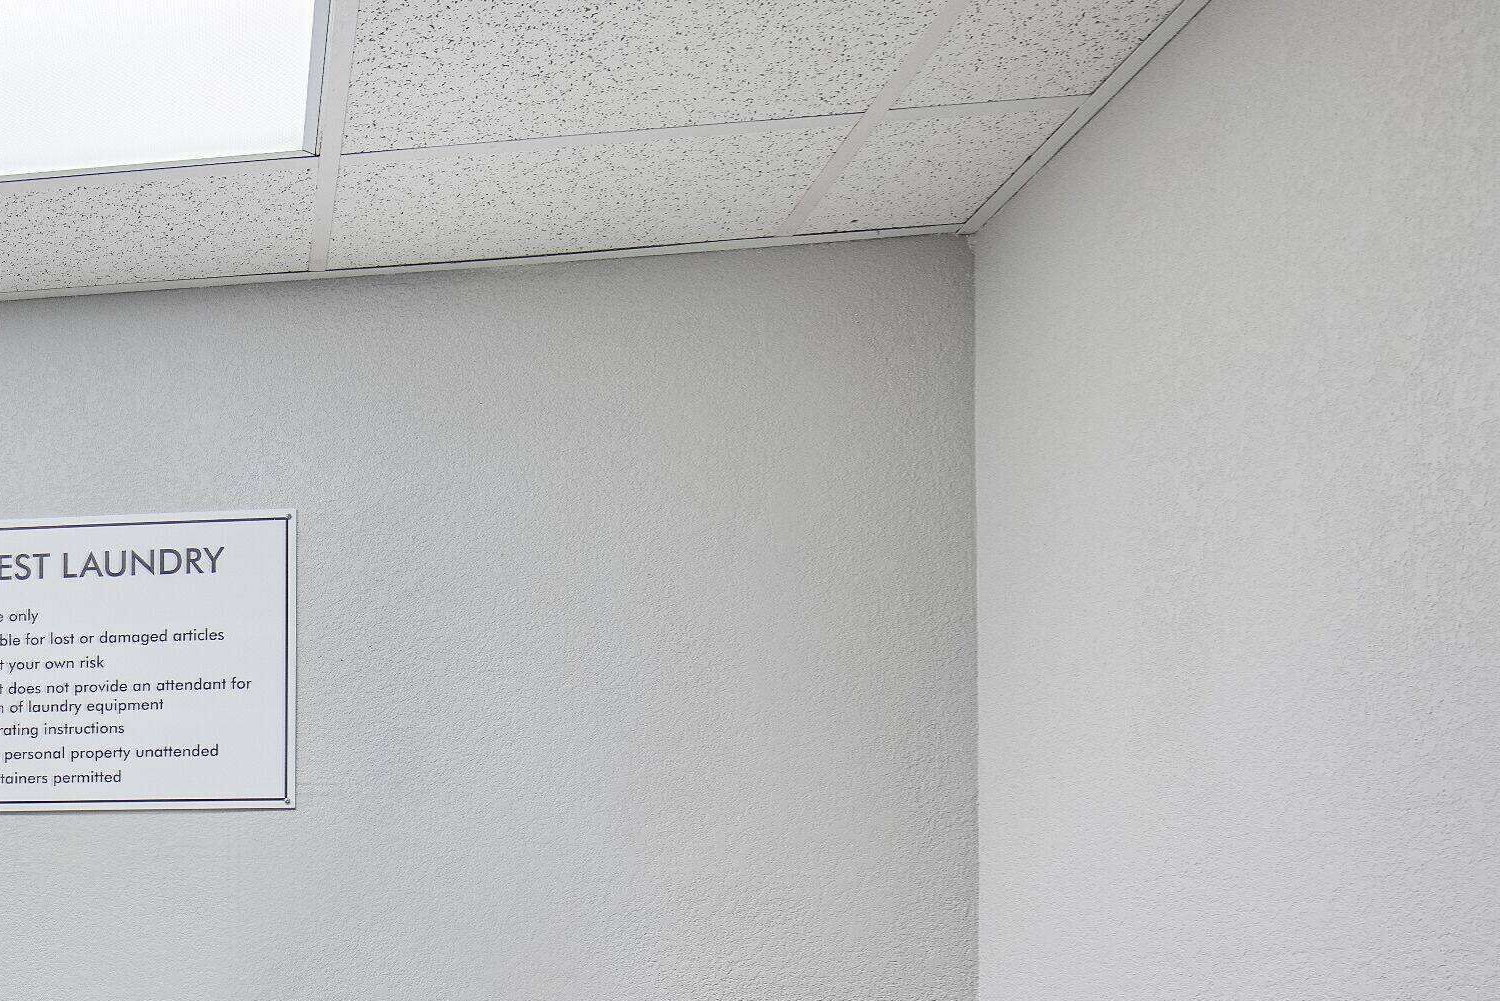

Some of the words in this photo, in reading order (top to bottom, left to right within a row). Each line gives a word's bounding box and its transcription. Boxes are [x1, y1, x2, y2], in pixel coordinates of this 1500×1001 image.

[63, 546, 225, 578] LAUNDRY
[9, 608, 39, 624] only
[25, 632, 46, 646] for
[50, 632, 74, 645] lost
[80, 635, 94, 644] or
[99, 628, 168, 646] damaged
[172, 628, 224, 642] articles
[8, 661, 40, 674] your
[45, 660, 74, 670] own
[80, 655, 104, 669] risk
[8, 682, 41, 695] does
[46, 682, 70, 694] not
[74, 679, 128, 696] provide
[132, 682, 151, 692] an
[156, 677, 226, 692] attendant
[230, 676, 252, 690] for
[10, 700, 24, 714] of
[28, 699, 82, 716] laundry
[86, 698, 164, 714] equipment
[44, 722, 125, 735] instructions
[4, 746, 65, 764] personal
[70, 747, 131, 762] property
[136, 743, 219, 758] unattended
[53, 770, 122, 786] permitted
